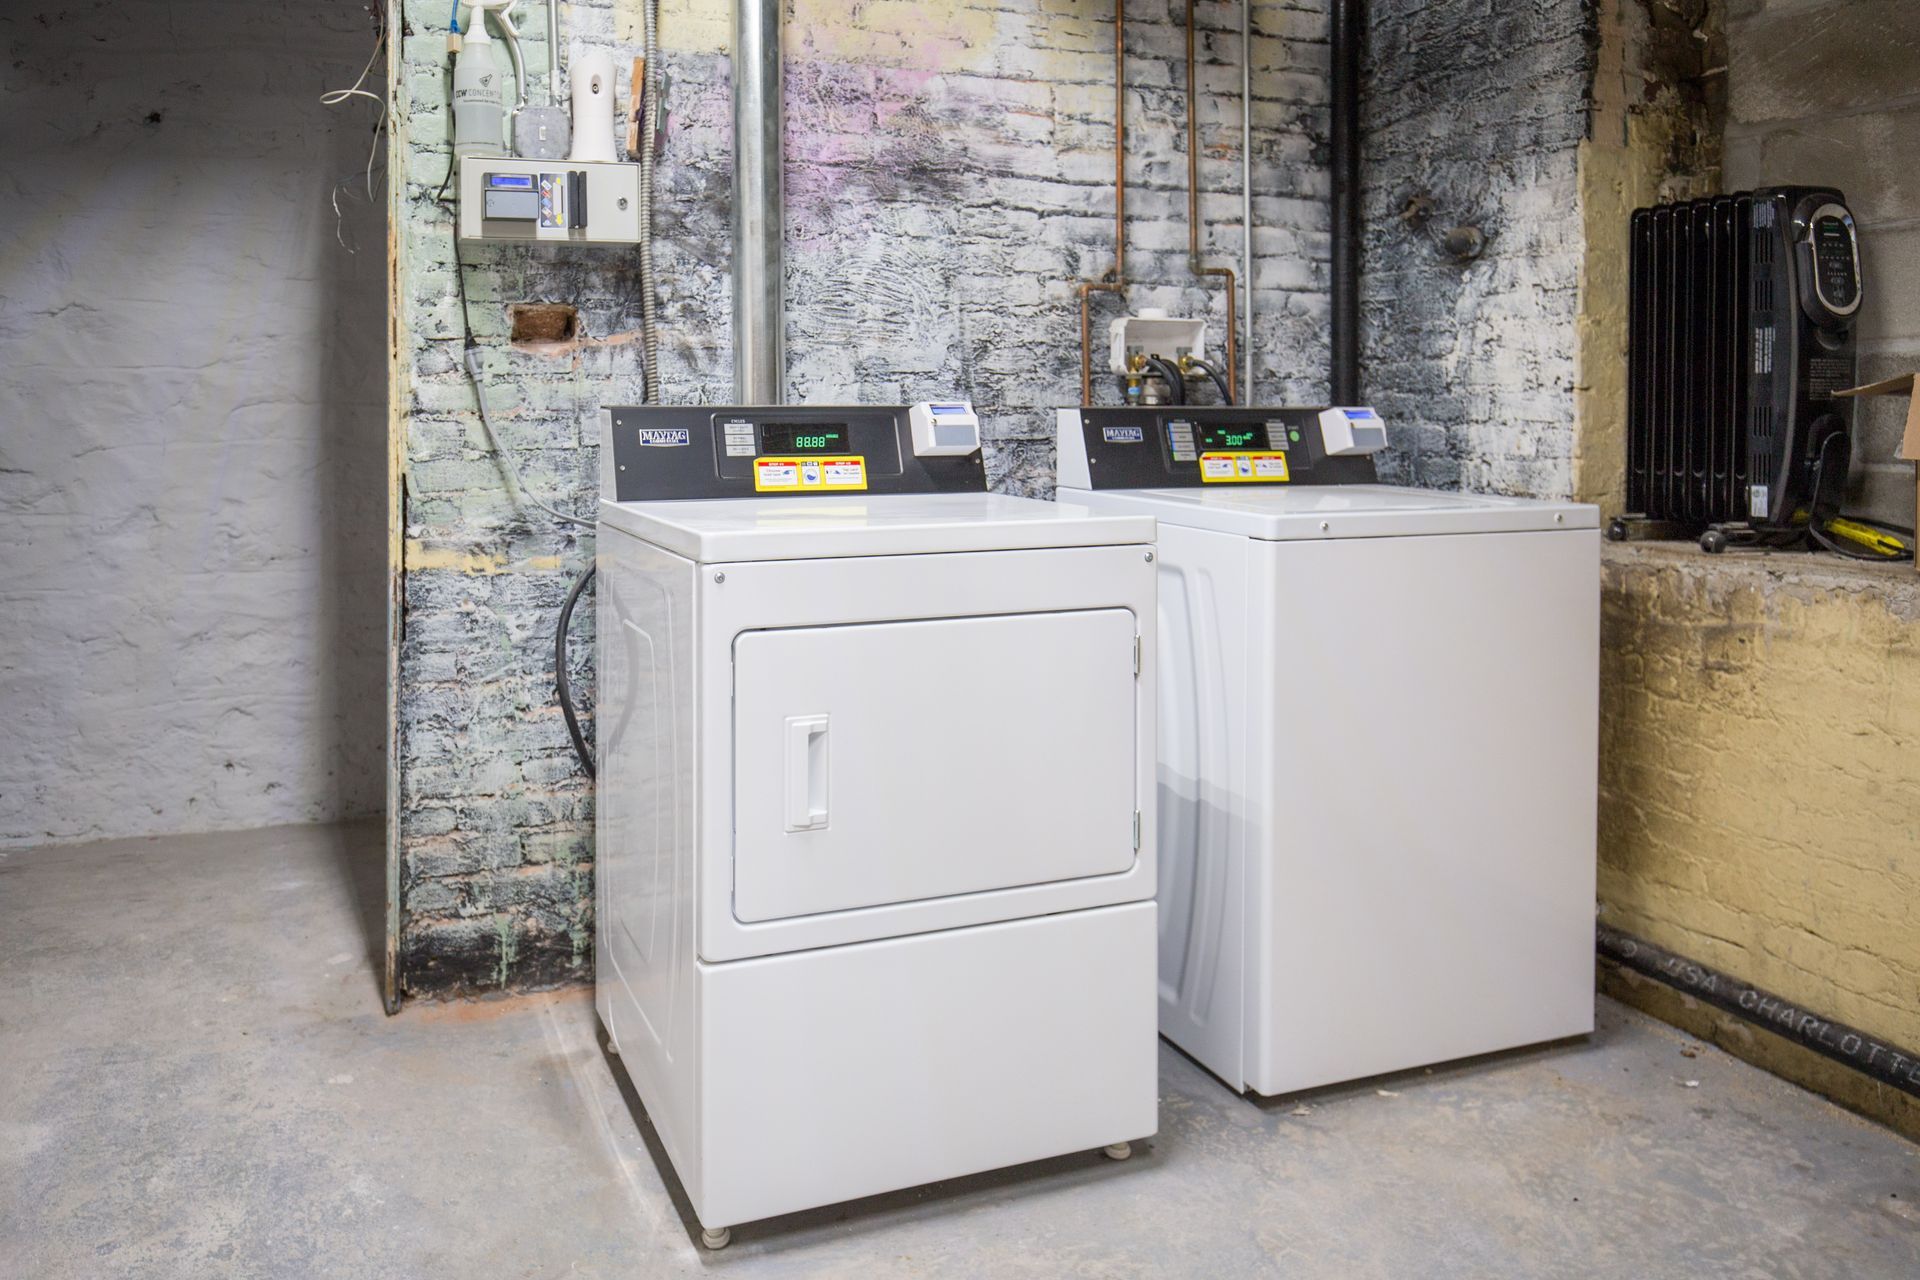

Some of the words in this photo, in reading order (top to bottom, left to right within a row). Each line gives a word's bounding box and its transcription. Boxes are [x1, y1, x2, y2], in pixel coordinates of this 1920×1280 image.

[643, 431, 686, 440] MAYTAG
[1106, 429, 1140, 437] MAYTAG
[796, 436, 825, 448] 88.88
[1226, 435, 1243, 446] 3.00
[1667, 958, 1717, 993] USA
